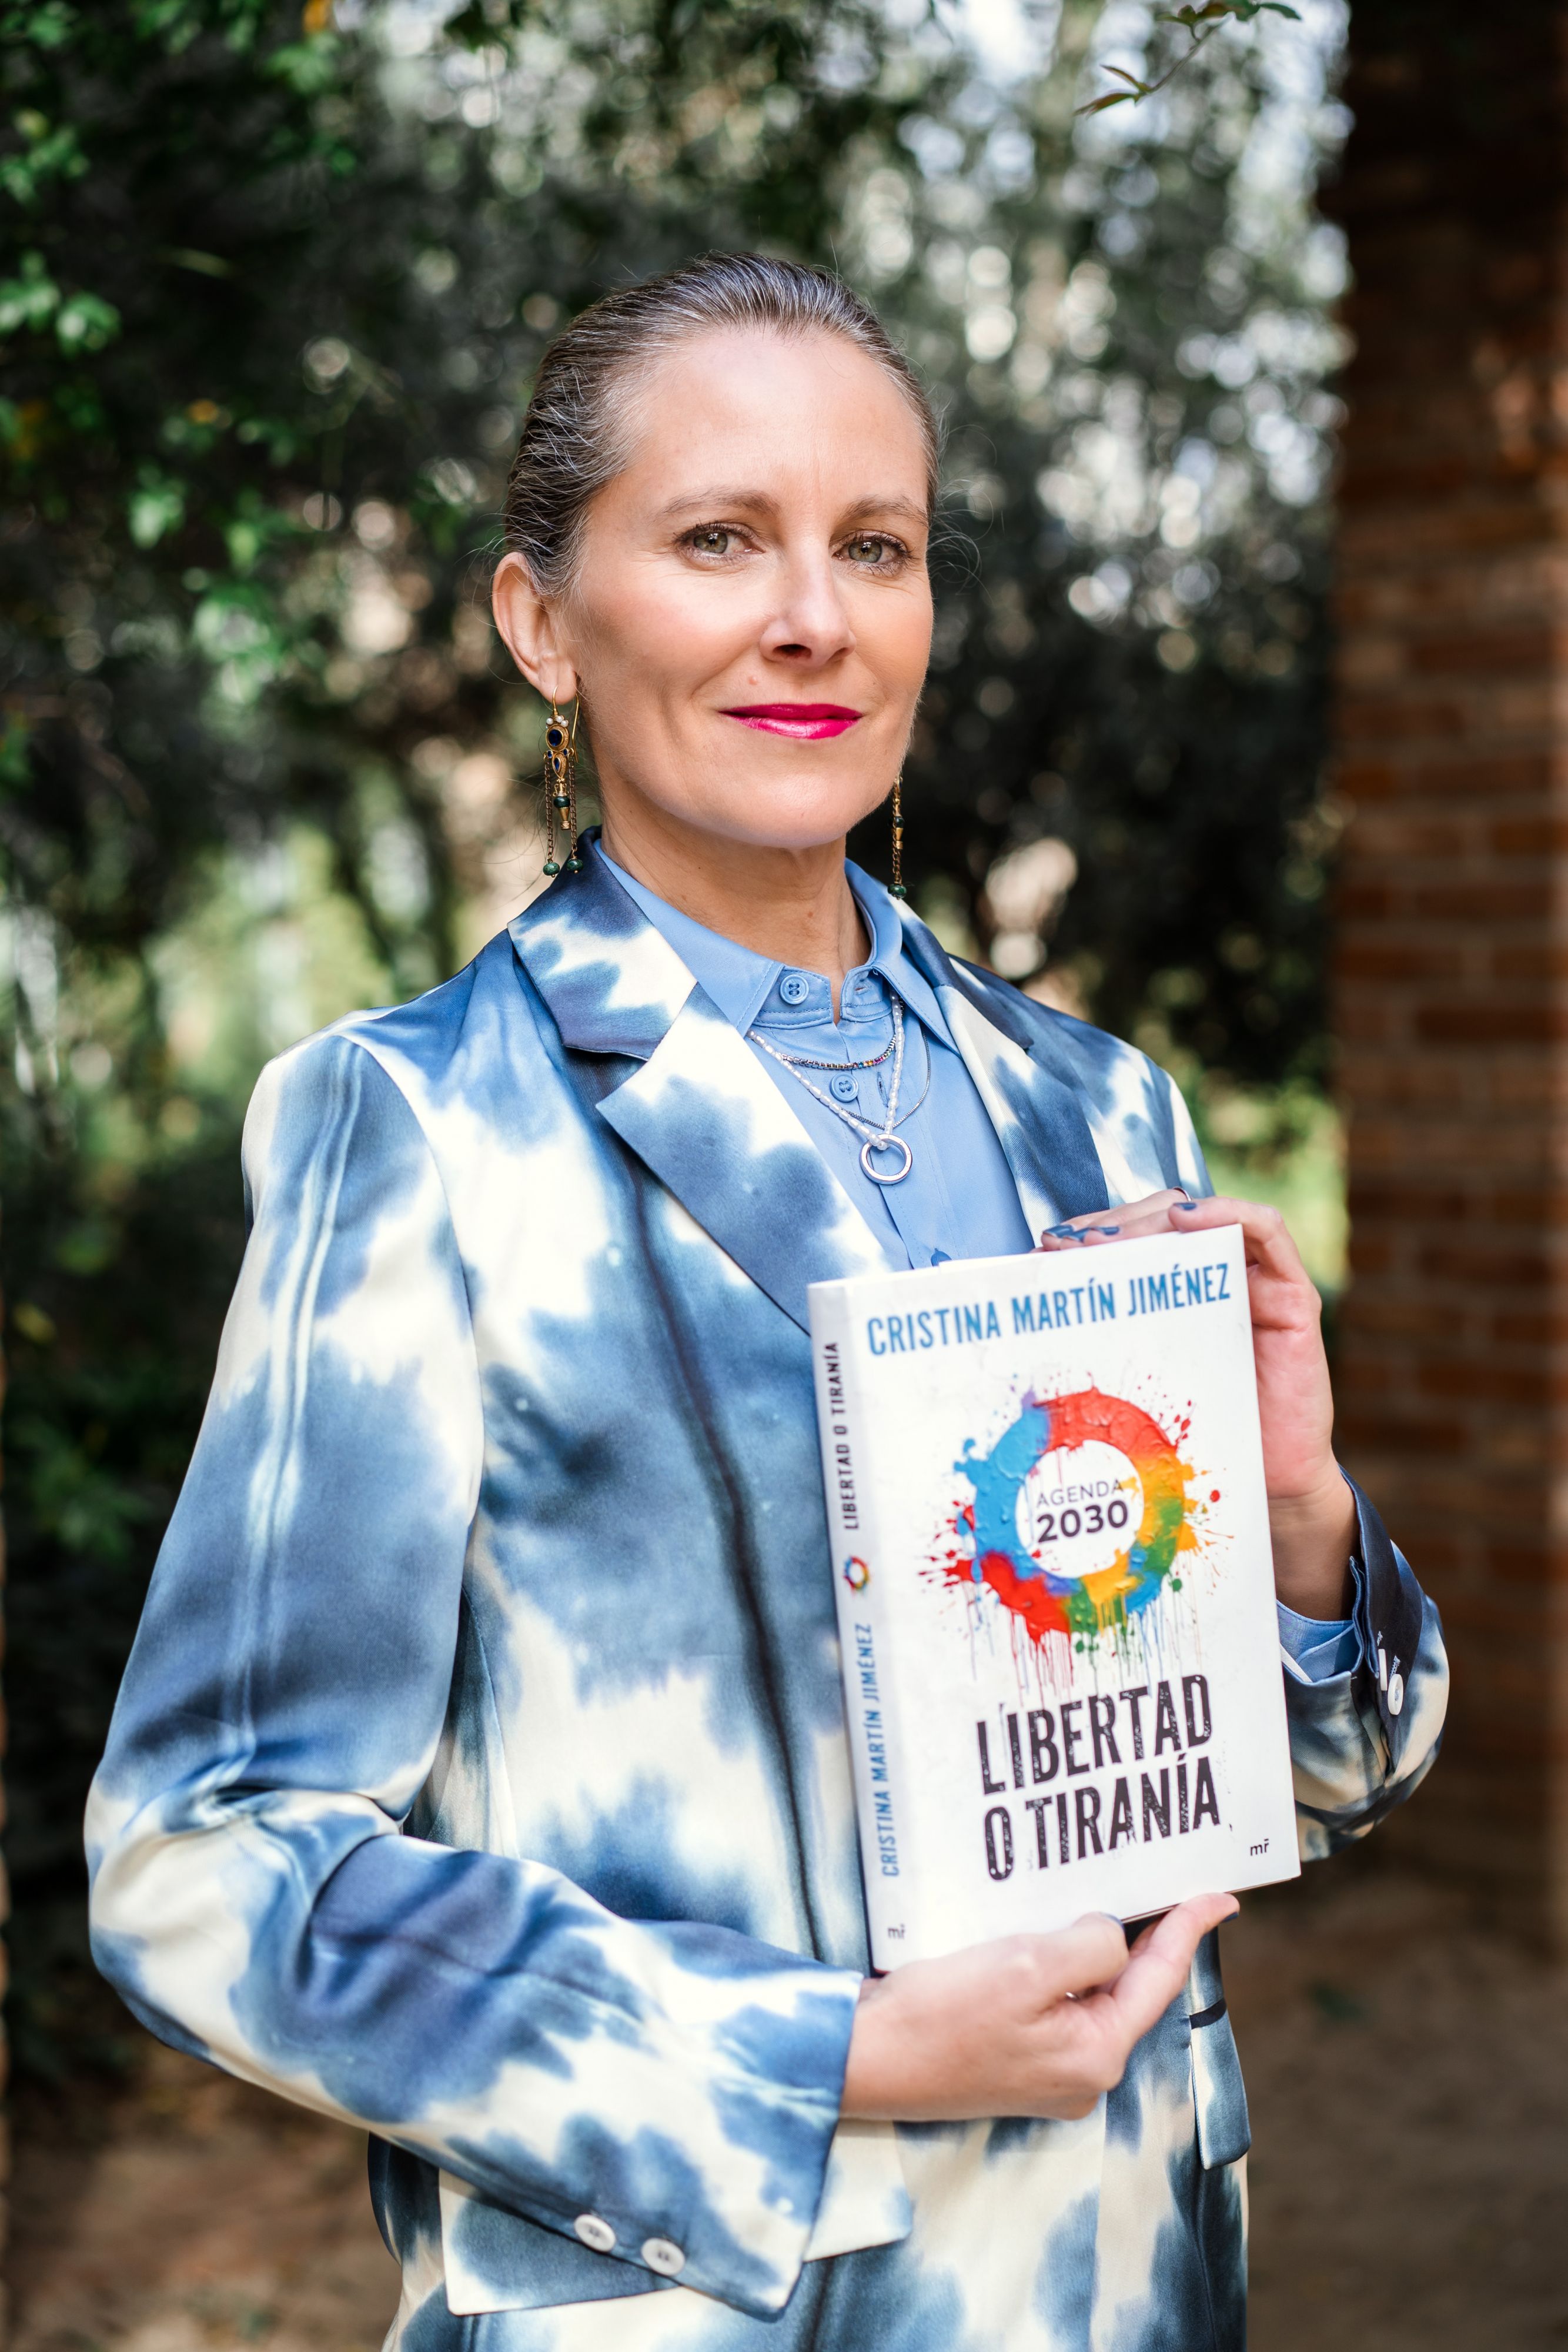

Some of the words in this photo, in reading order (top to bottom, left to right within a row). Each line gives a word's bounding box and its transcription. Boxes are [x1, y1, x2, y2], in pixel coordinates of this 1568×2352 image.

[867, 1301, 1001, 1357] CRISTINA
[1012, 1277, 1117, 1335] MARTÍN
[1127, 1263, 1231, 1315] JIMÉNEZ
[823, 1342, 845, 1416] TIRANÍA
[834, 1425, 848, 1436] O
[836, 1444, 859, 1530] LIBERTAD
[1037, 1478, 1124, 1509] AGENDA
[1037, 1499, 1129, 1544] 2030
[856, 1623, 880, 1703] JIMÉNEZ
[864, 1710, 888, 1782] MARTÍN
[977, 1674, 1213, 1796] LIBERTAD
[875, 1790, 900, 1877] CRISTINA
[984, 1806, 1015, 1881] O
[1025, 1752, 1221, 1870] TIRANÍA
